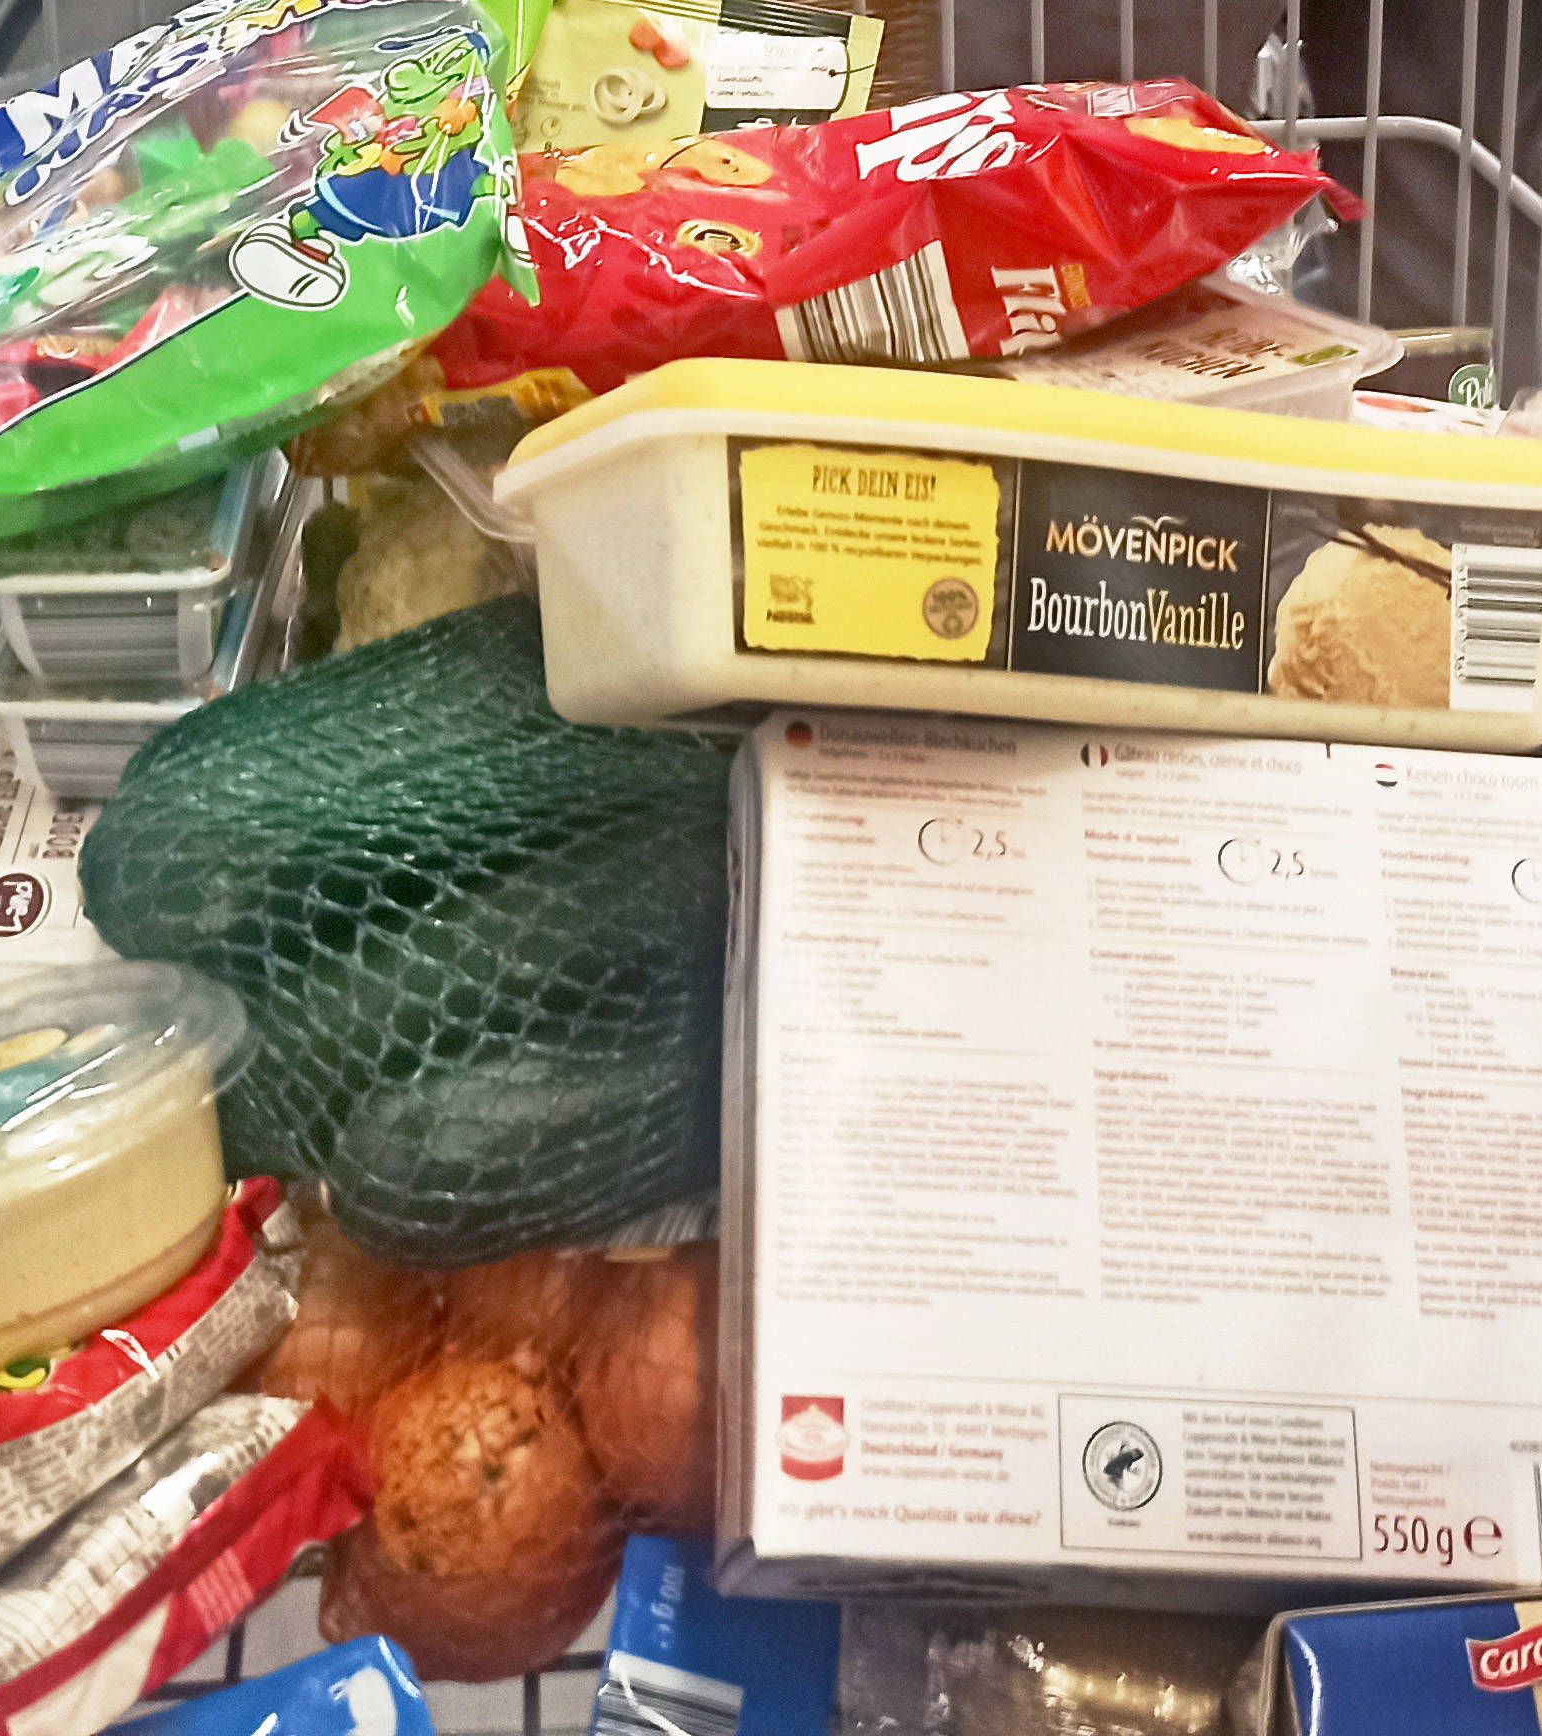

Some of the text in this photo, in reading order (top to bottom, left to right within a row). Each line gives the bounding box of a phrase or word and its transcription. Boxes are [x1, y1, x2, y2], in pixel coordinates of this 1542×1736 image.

[812, 464, 937, 503] PICK DEIN EIS!
[1044, 515, 1239, 572] MÖVENPICK
[1026, 576, 1247, 652] BourbonVanille
[971, 828, 1009, 862] 2,5
[1269, 849, 1307, 881] 2,5
[861, 1442, 938, 1457] Deutschland
[893, 1505, 959, 1523] Qualität
[963, 1509, 989, 1523] wie
[994, 1508, 1042, 1527] diese?
[1372, 1513, 1430, 1555] 550
[1435, 1524, 1455, 1567] g
